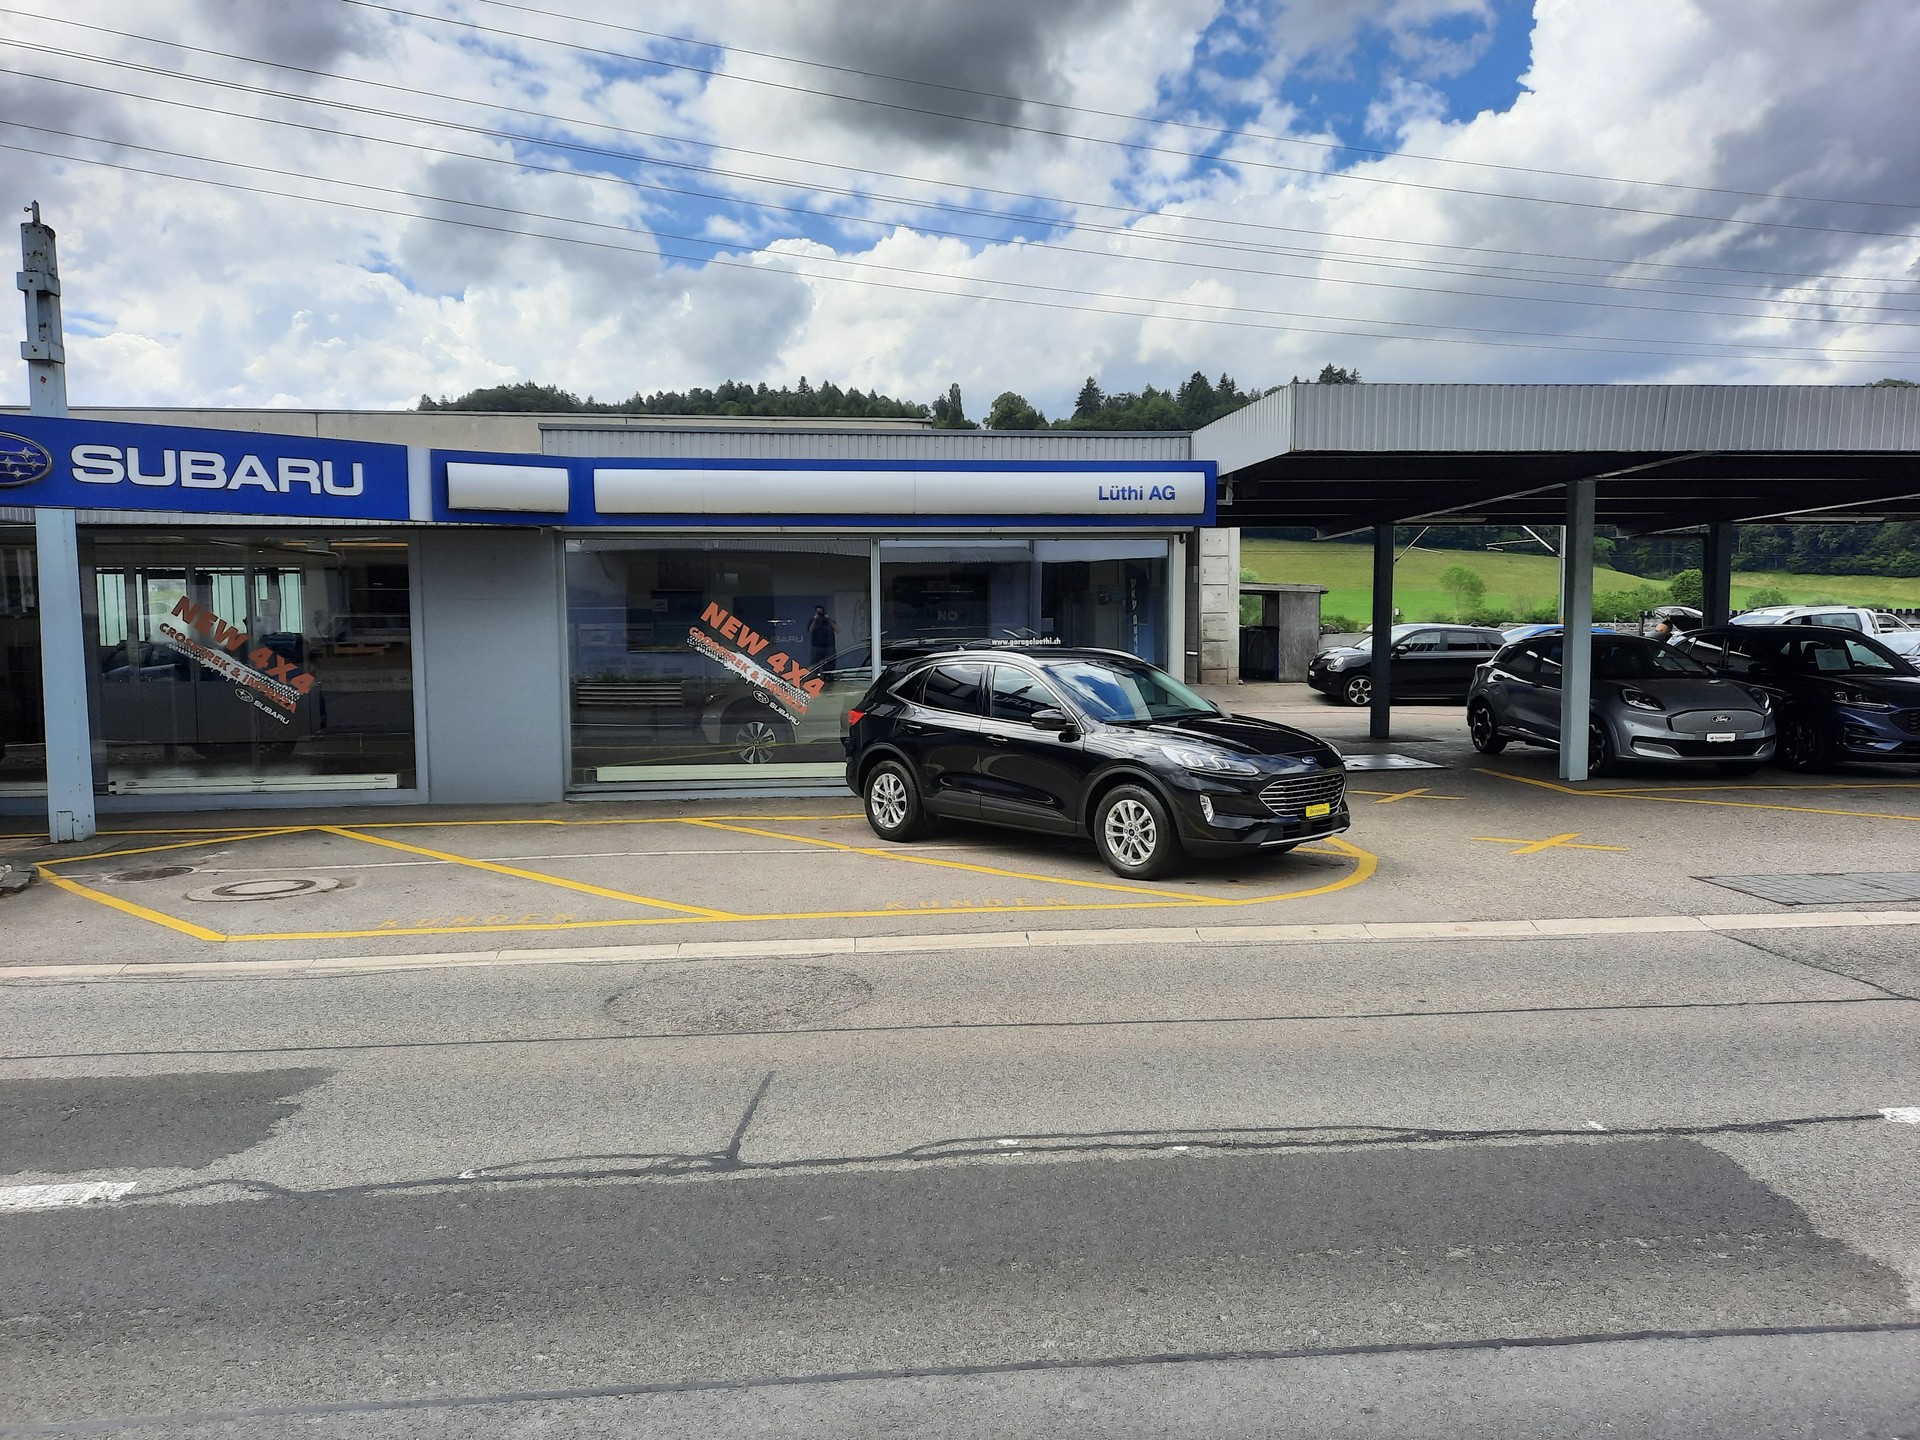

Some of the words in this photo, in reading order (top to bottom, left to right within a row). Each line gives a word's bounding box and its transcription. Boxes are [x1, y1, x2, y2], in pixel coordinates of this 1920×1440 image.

[71, 444, 364, 496] SUBARU
[1098, 485, 1143, 501] Lüthi
[1148, 485, 1176, 501] AG
[171, 595, 249, 651] NEW
[249, 646, 315, 695] 4X4
[770, 635, 804, 644] BARU
[700, 601, 769, 656] NEW
[767, 652, 826, 699] 4X4
[230, 667, 241, 679] &
[750, 670, 760, 681] &
[253, 700, 290, 725] SUBARU
[769, 701, 801, 726] SUBARU
[885, 897, 1068, 909] KUNDEN
[378, 913, 577, 928] KUNDEN
